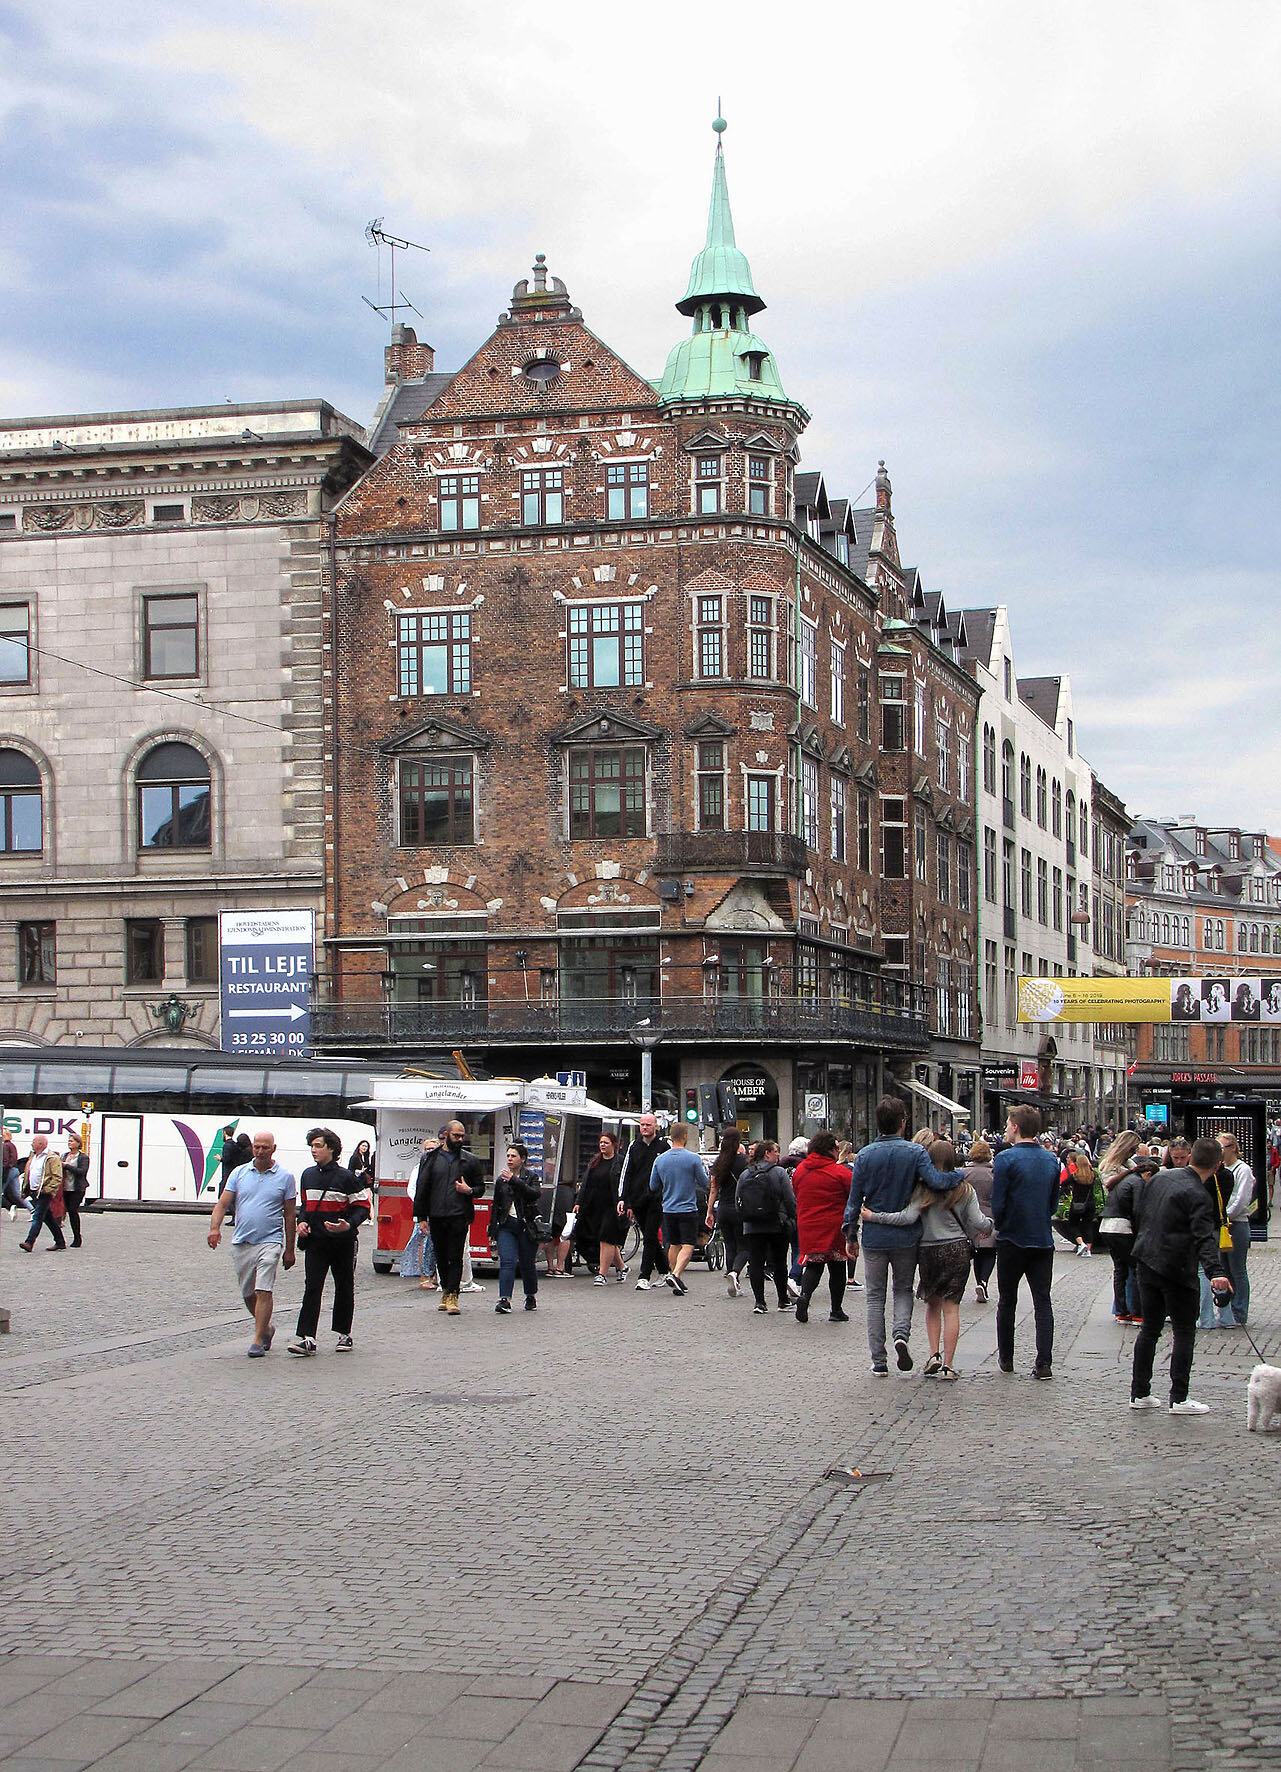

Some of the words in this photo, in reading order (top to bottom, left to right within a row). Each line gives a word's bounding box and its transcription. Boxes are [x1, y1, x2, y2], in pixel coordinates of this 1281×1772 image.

[227, 956, 259, 974] TIL
[265, 955, 307, 977] LEJE
[228, 982, 307, 994] RESTAURANT
[232, 1033, 248, 1045] 33
[250, 1033, 267, 1045] 25
[269, 1033, 285, 1044] 30
[288, 1033, 305, 1044] 00
[984, 1067, 1015, 1075] Souvenirs
[755, 1078, 766, 1086] OF
[1022, 1075, 1036, 1087] illy
[732, 1086, 766, 1096] AMBER
